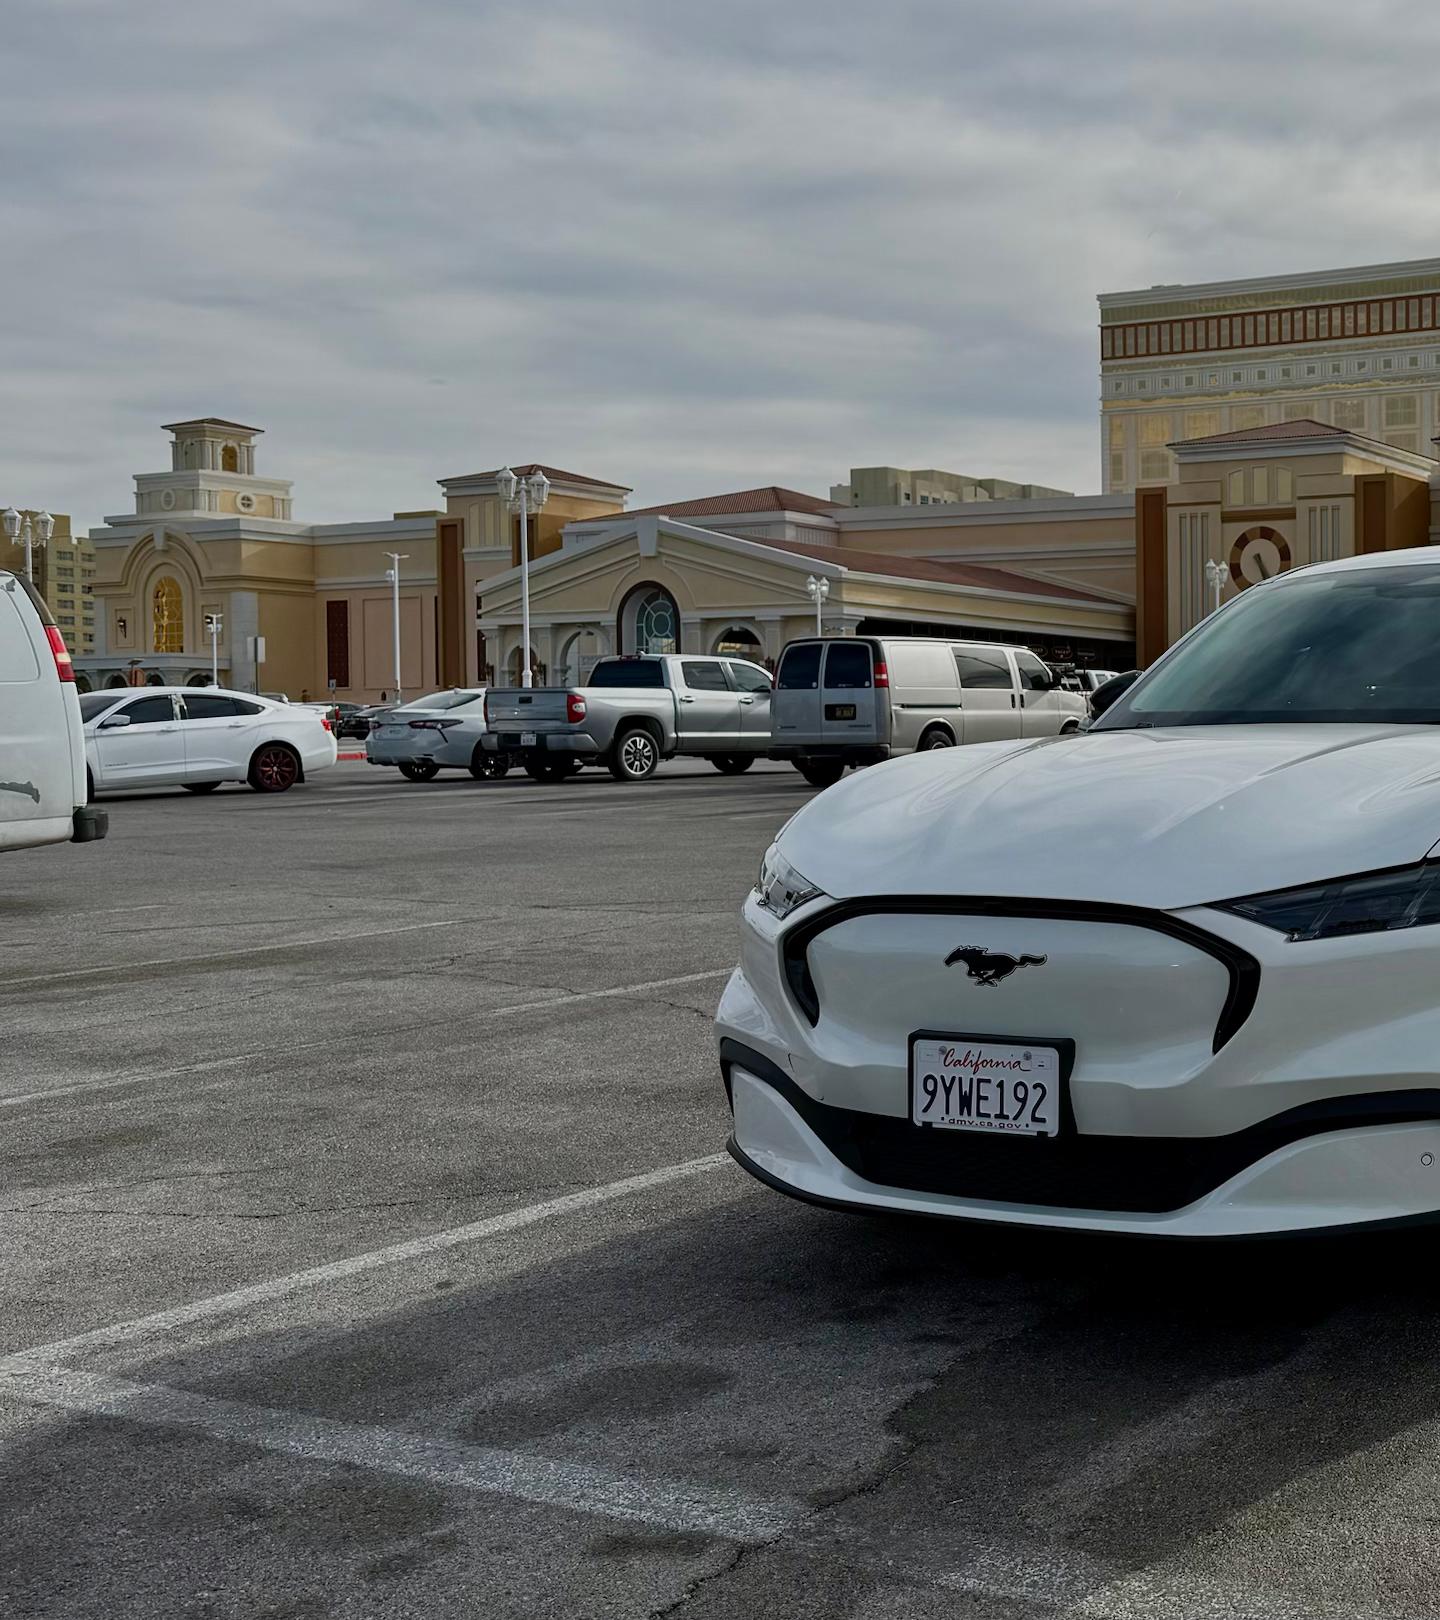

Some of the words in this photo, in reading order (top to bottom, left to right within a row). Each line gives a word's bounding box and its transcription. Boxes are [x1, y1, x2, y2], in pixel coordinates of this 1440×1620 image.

[943, 1048, 1031, 1075] California
[922, 1074, 1047, 1123] 9YWE192
[948, 1118, 1022, 1129] dmv.ca.gov
